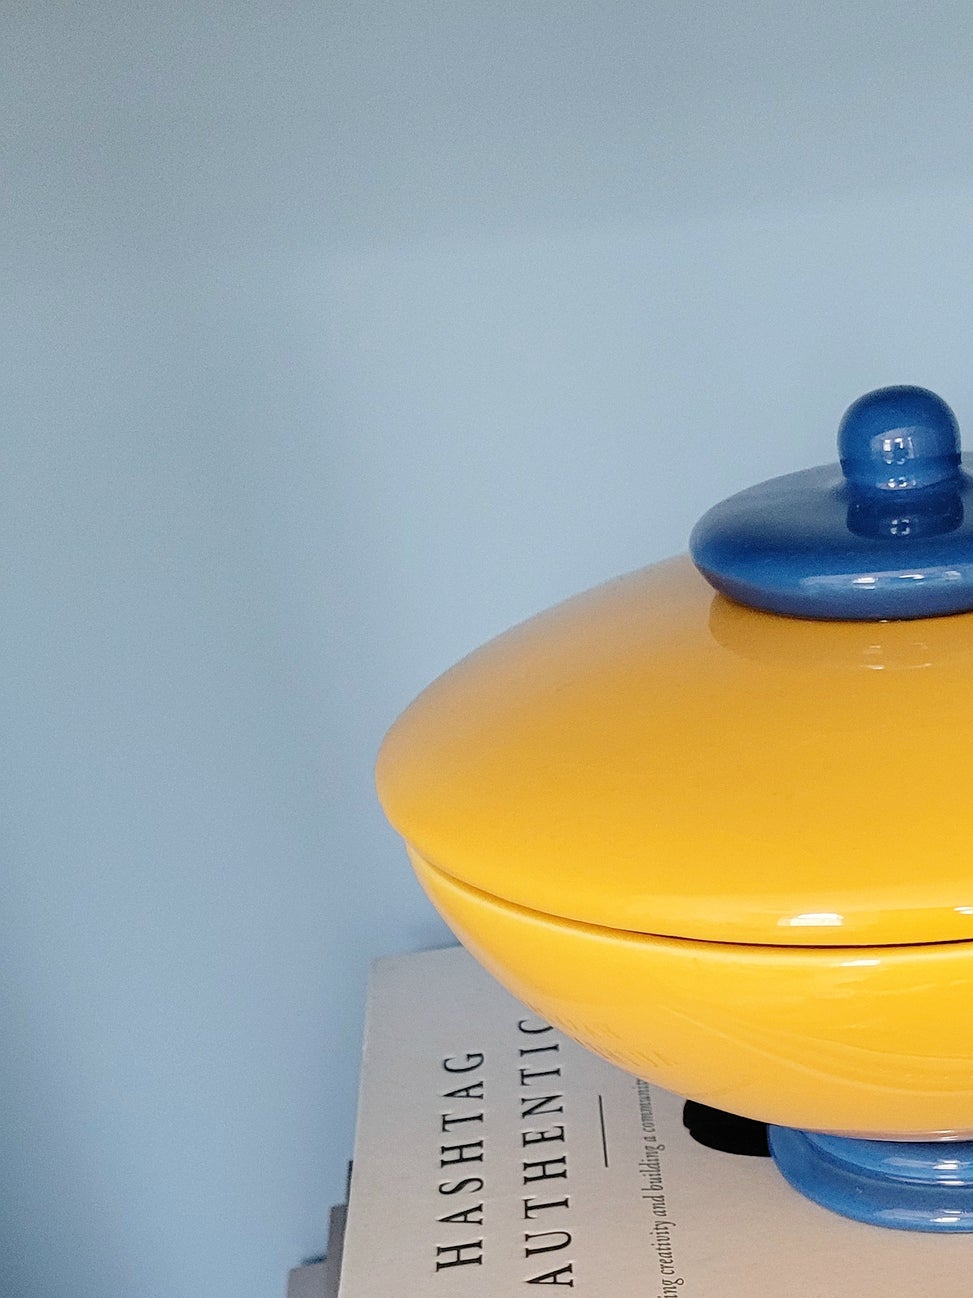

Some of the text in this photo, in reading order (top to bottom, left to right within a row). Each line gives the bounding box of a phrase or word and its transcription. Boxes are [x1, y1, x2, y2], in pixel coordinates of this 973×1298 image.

[436, 1051, 484, 1272] HASHTAG
[518, 1019, 574, 1288] AUTHENTIC
[639, 1144, 666, 1193] building
[643, 1194, 668, 1218] and
[650, 1219, 676, 1276] creativity
